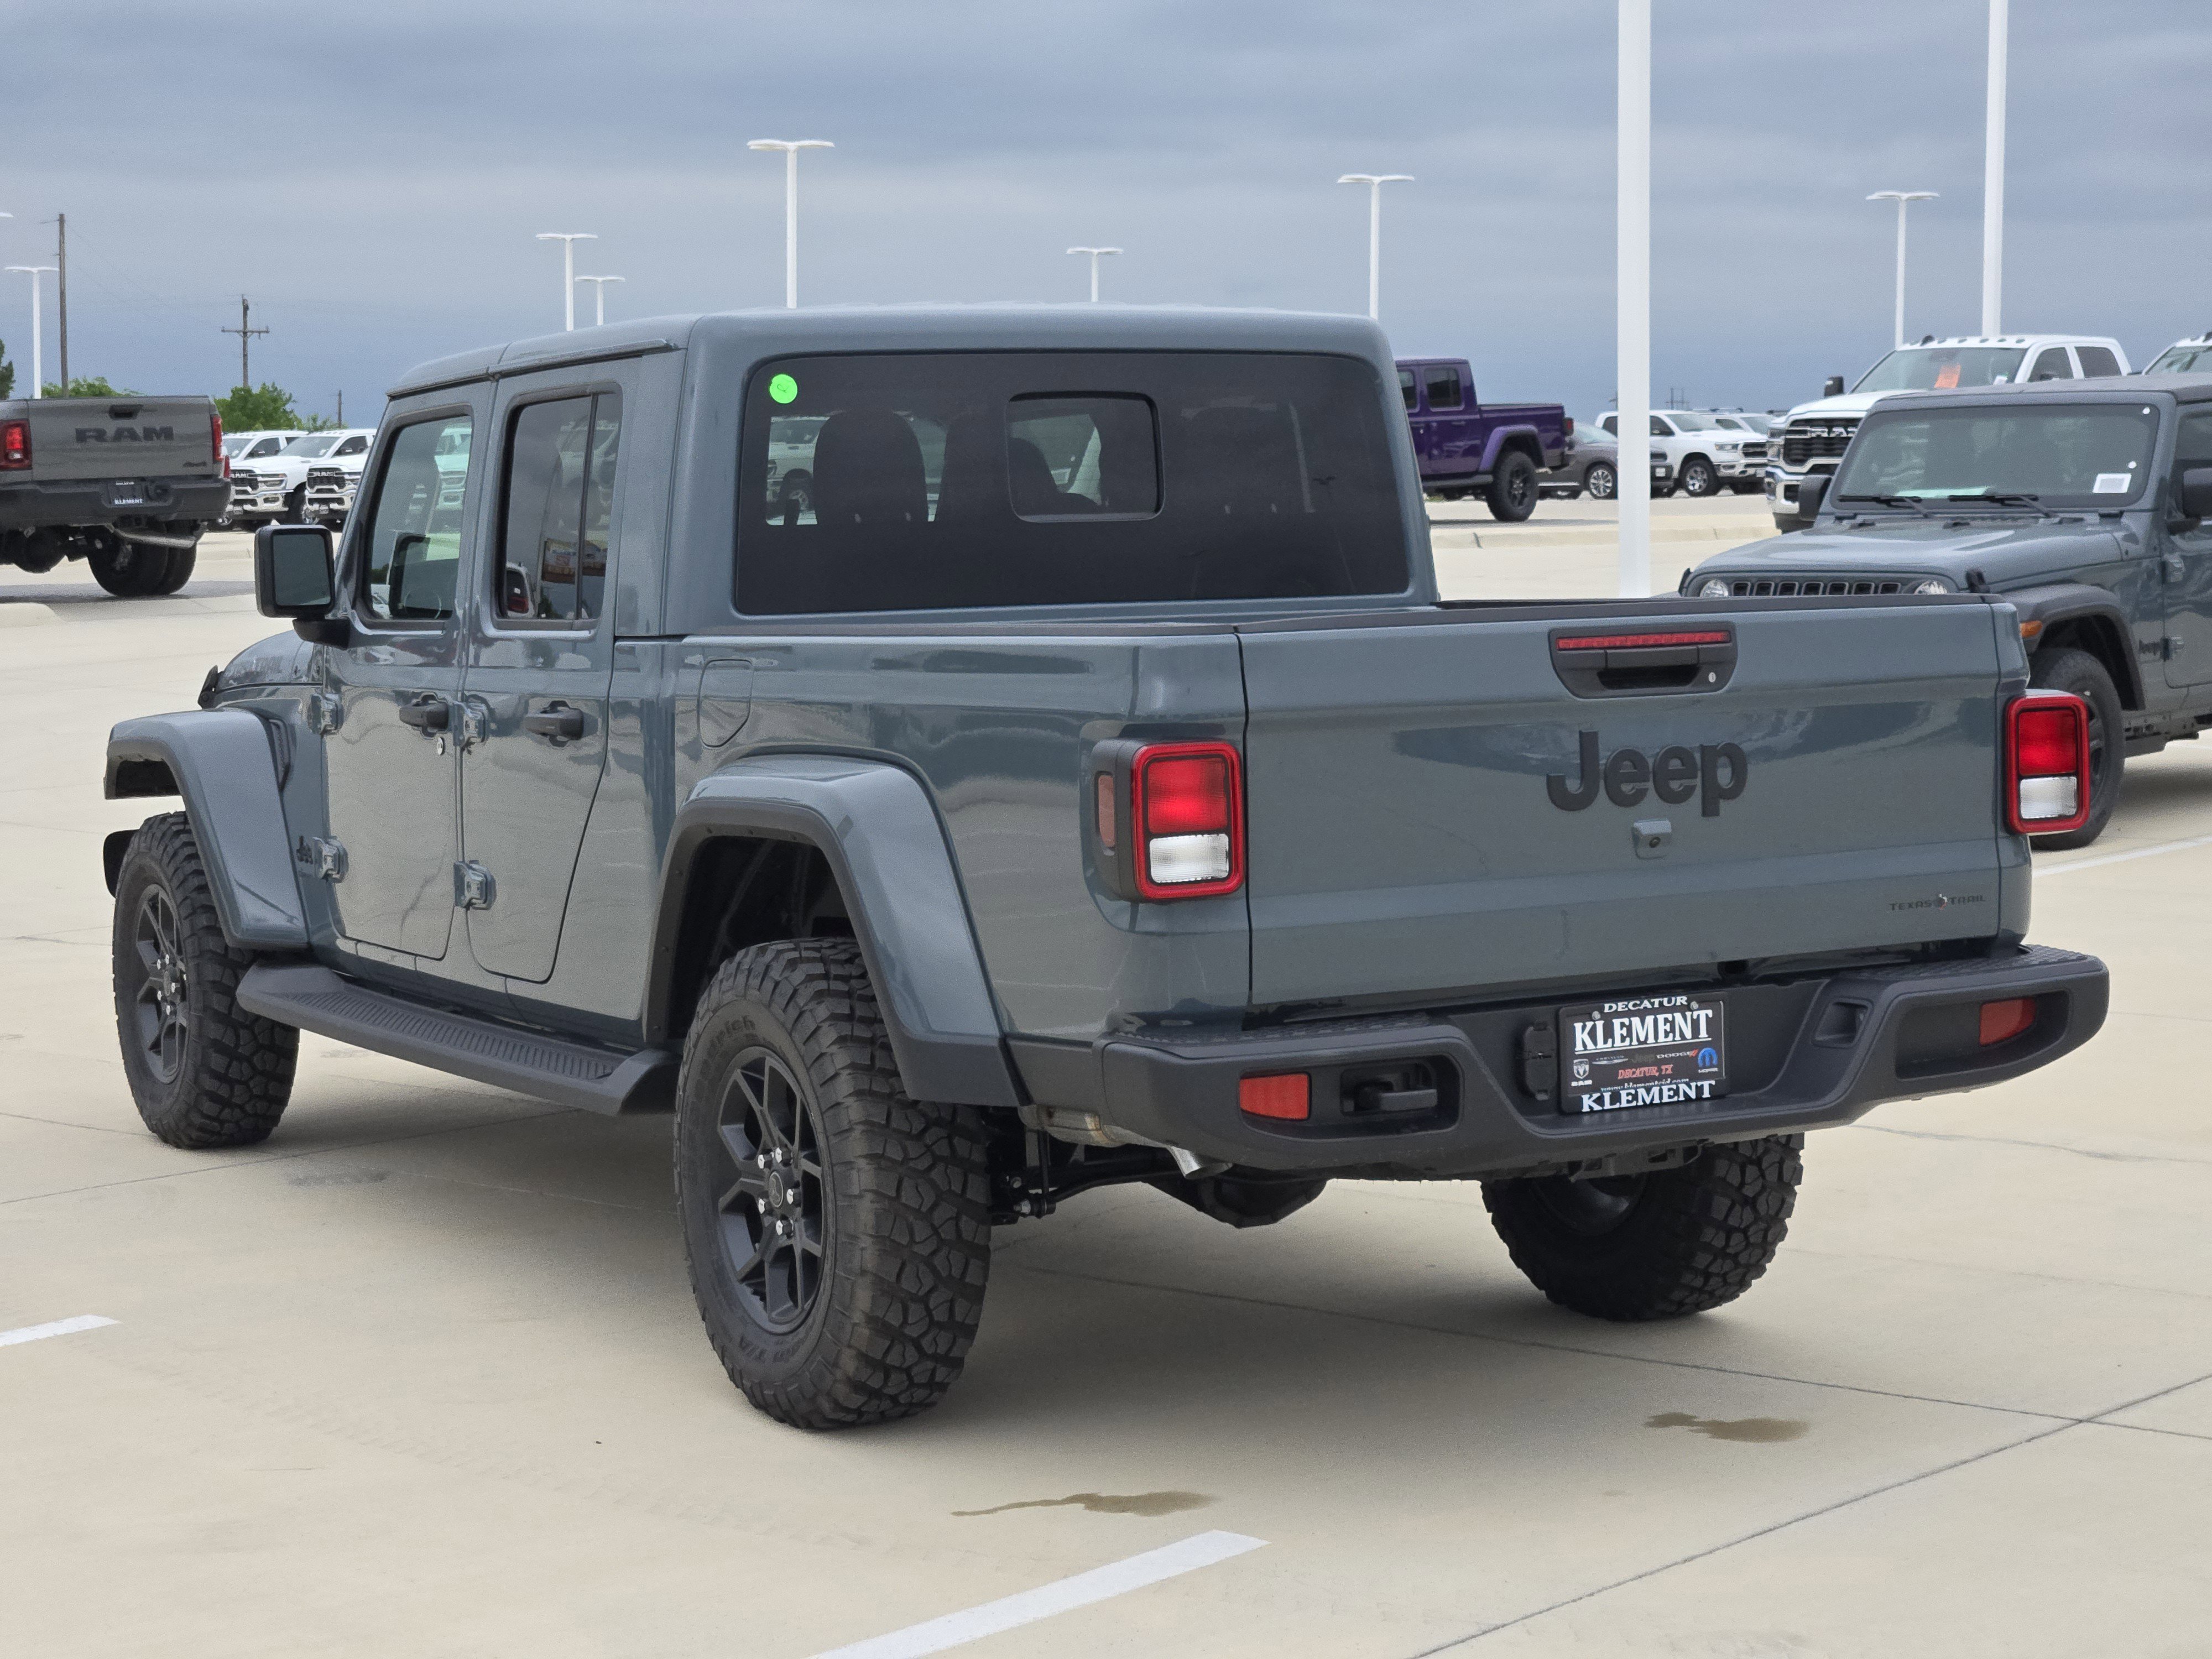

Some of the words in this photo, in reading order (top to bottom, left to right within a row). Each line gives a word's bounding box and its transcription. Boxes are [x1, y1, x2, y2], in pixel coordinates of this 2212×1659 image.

[75, 426, 174, 443] RAM
[1546, 730, 1747, 817] Jeep
[1888, 900, 1932, 911] TEXAS
[1949, 895, 1986, 905] TRAIL
[1604, 996, 1688, 1013] DECATUR
[1573, 1009, 1713, 1051] KLEMENT
[1661, 1064, 1673, 1074] TX
[1581, 1080, 1715, 1112] KLEMENT
